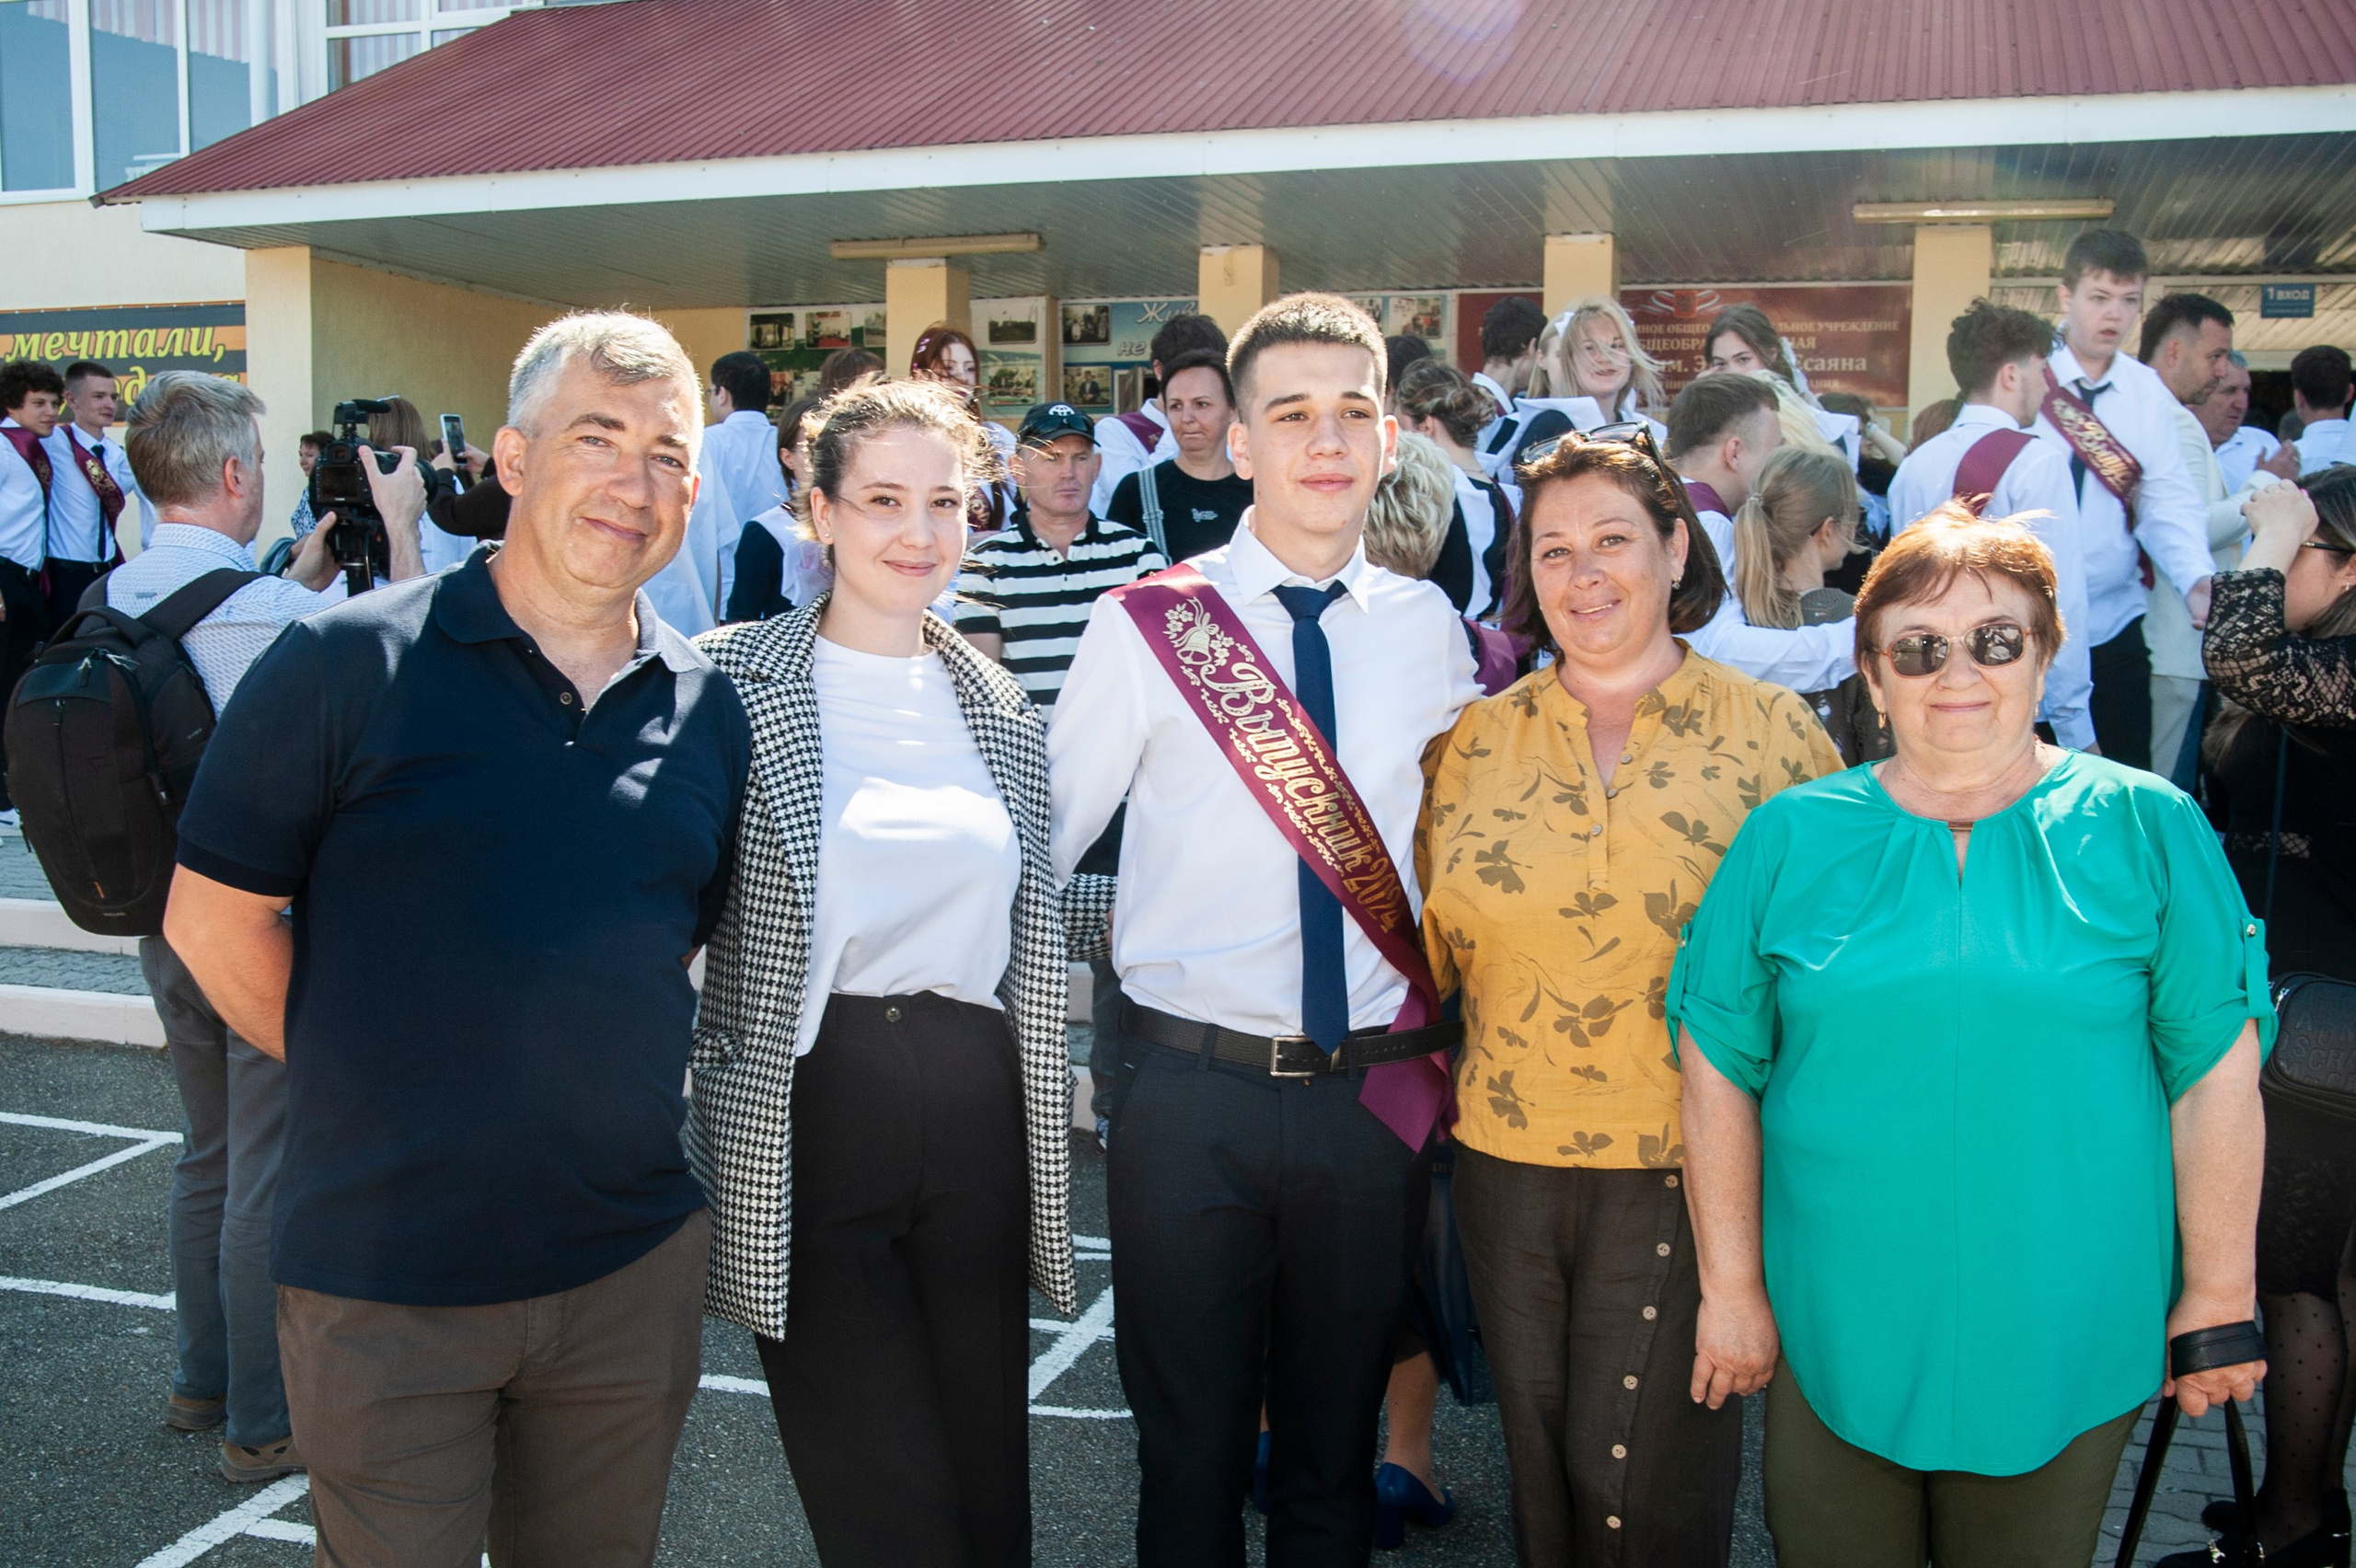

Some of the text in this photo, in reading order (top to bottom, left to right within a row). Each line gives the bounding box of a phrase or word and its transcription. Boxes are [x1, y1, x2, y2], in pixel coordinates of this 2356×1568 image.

[2267, 287, 2274, 300] 1
[5, 327, 225, 363] мечтали,
[1199, 662, 1372, 872] Выпускник
